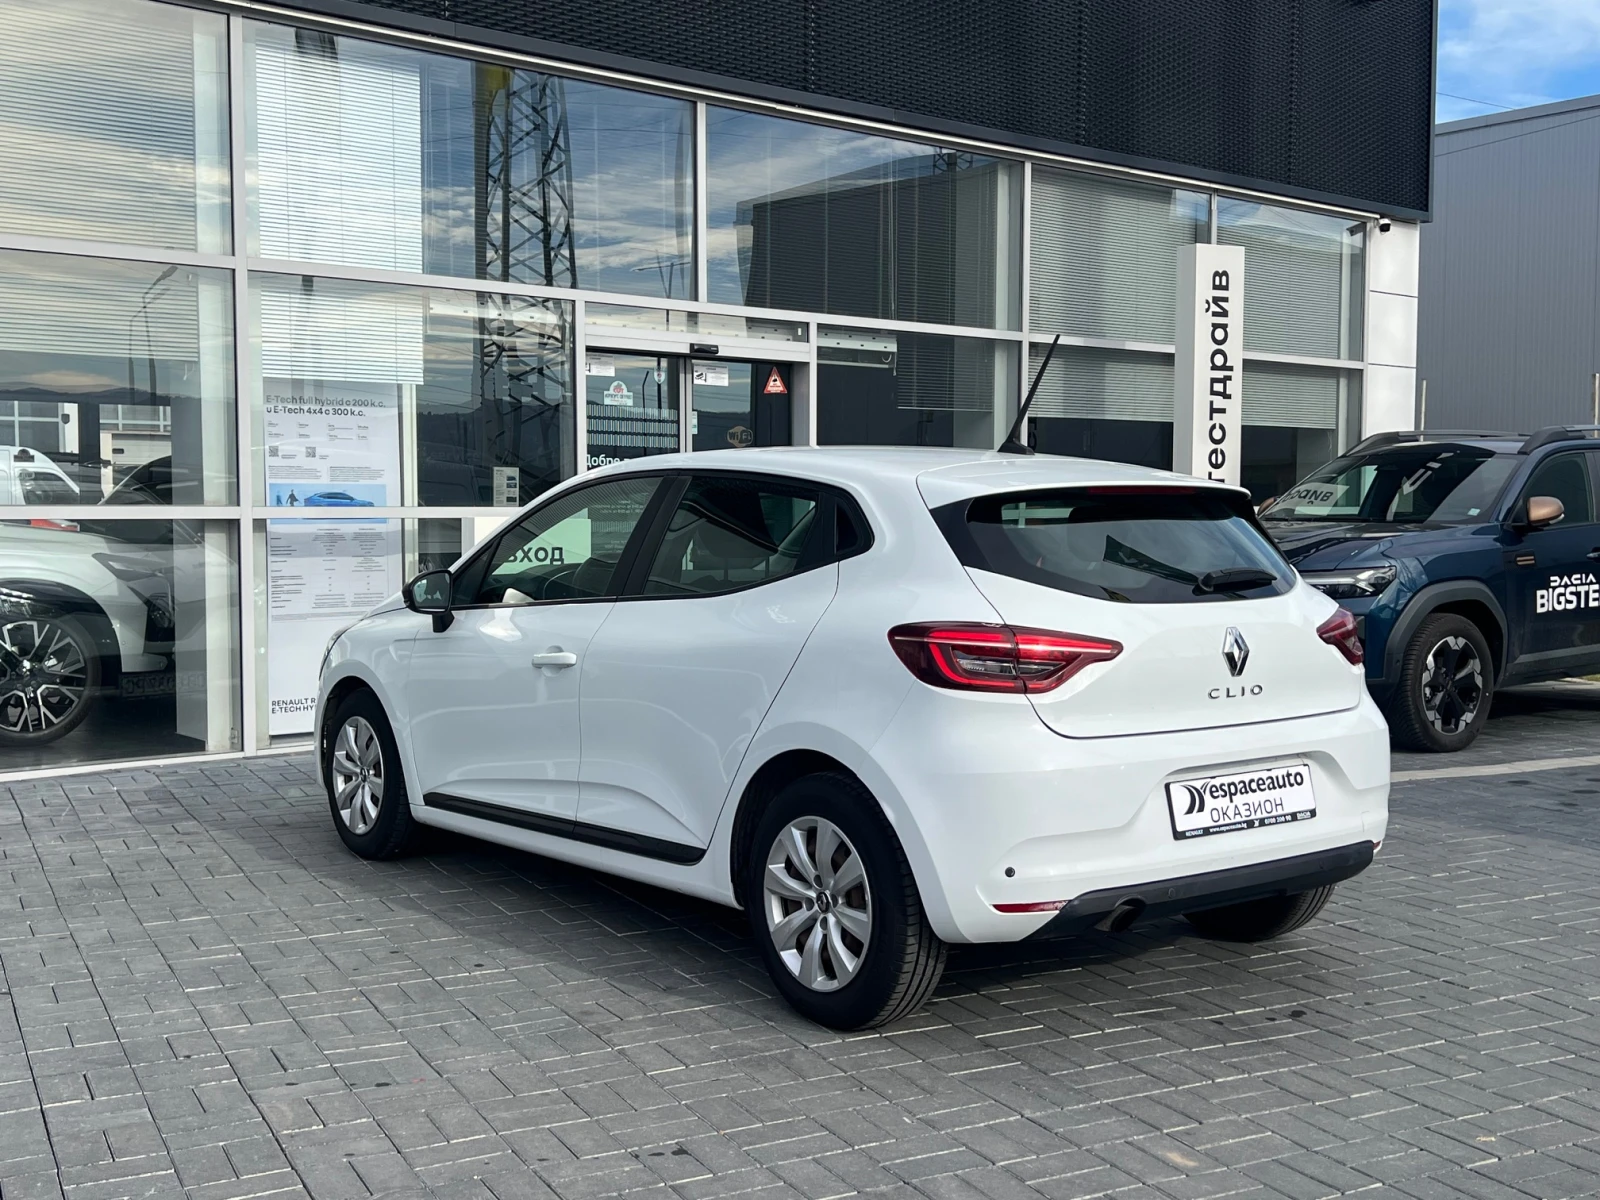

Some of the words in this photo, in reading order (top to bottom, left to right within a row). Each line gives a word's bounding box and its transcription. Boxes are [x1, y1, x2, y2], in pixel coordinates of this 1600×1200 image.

[266, 395, 298, 404] E-Tech
[299, 395, 313, 405] full
[314, 396, 344, 407] hybrid
[352, 398, 369, 407] 200
[273, 405, 305, 415] E-Tech
[306, 406, 323, 415] 4x4
[331, 407, 349, 416] 300
[1549, 573, 1597, 586] DACIA
[1536, 584, 1600, 613] BIGSTE
[1207, 684, 1263, 700] CLIO
[271, 698, 309, 707] RENAULT
[271, 705, 302, 714] E-TECH
[303, 704, 317, 712] HY
[1209, 769, 1304, 803] espaceauto
[1210, 797, 1285, 823] ОКАЗИОН
